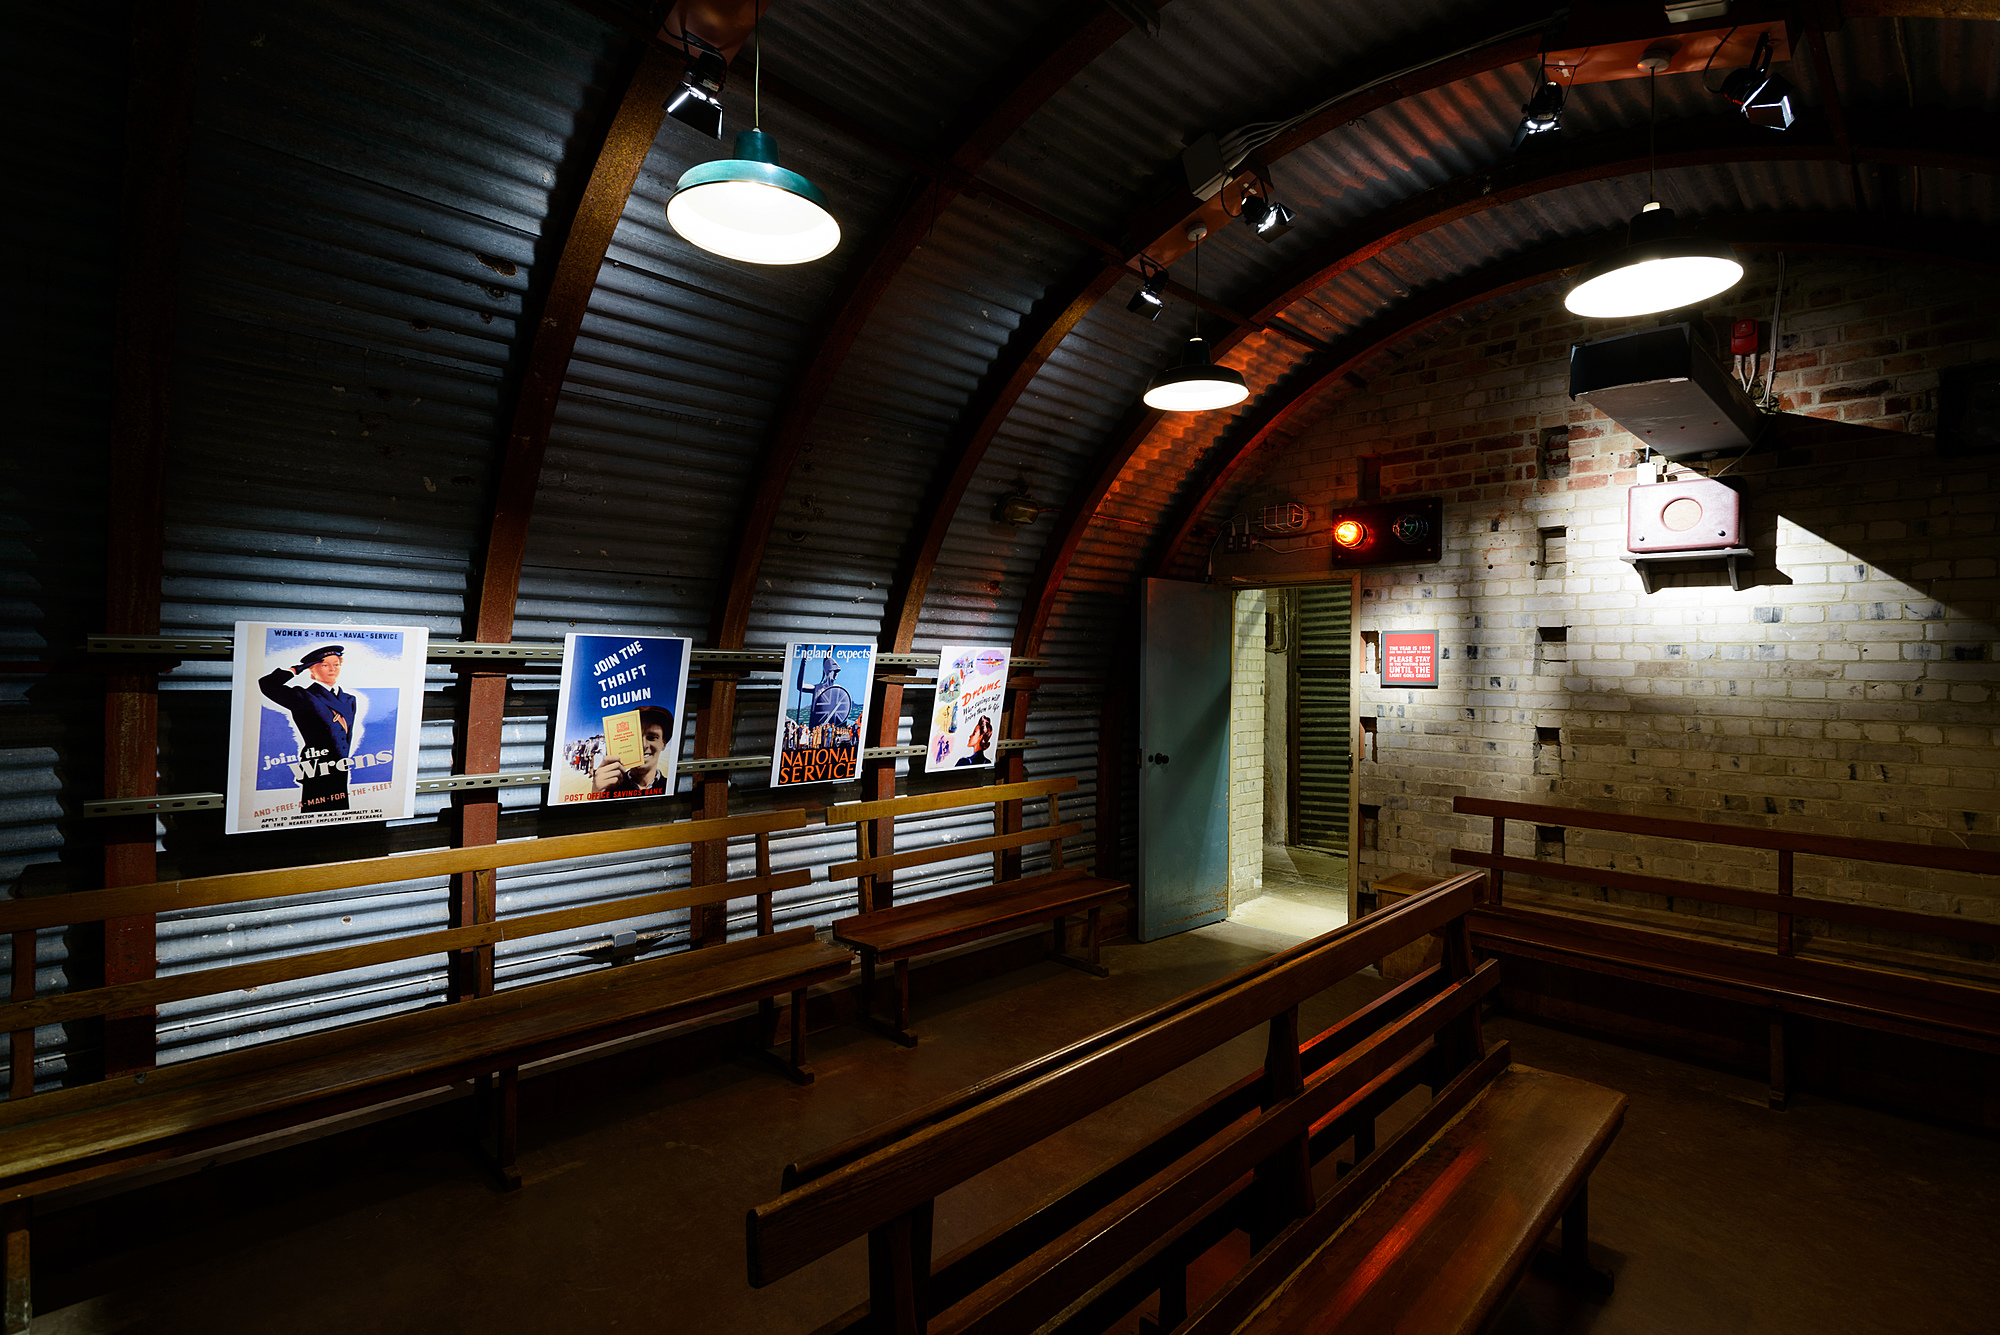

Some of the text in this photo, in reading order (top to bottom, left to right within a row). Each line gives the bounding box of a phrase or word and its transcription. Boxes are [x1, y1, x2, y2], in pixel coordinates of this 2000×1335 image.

[593, 640, 643, 676] JOIN THE
[793, 644, 871, 662] England expects
[598, 664, 647, 692] THRIFT
[600, 688, 651, 709] COLUMN
[263, 747, 329, 770] join the
[287, 750, 393, 780] Wrens
[781, 746, 857, 768] NATIONAL
[780, 762, 856, 784] SERVICE
[254, 808, 271, 818] AND
[276, 803, 294, 812] FREE
[307, 796, 326, 806] MAN
[330, 792, 346, 801] FOR
[351, 788, 366, 796] THE
[372, 782, 392, 792] FLEET
[564, 794, 584, 802] POST
[587, 792, 610, 800] OFFICE
[613, 790, 642, 798] SAVINGS
